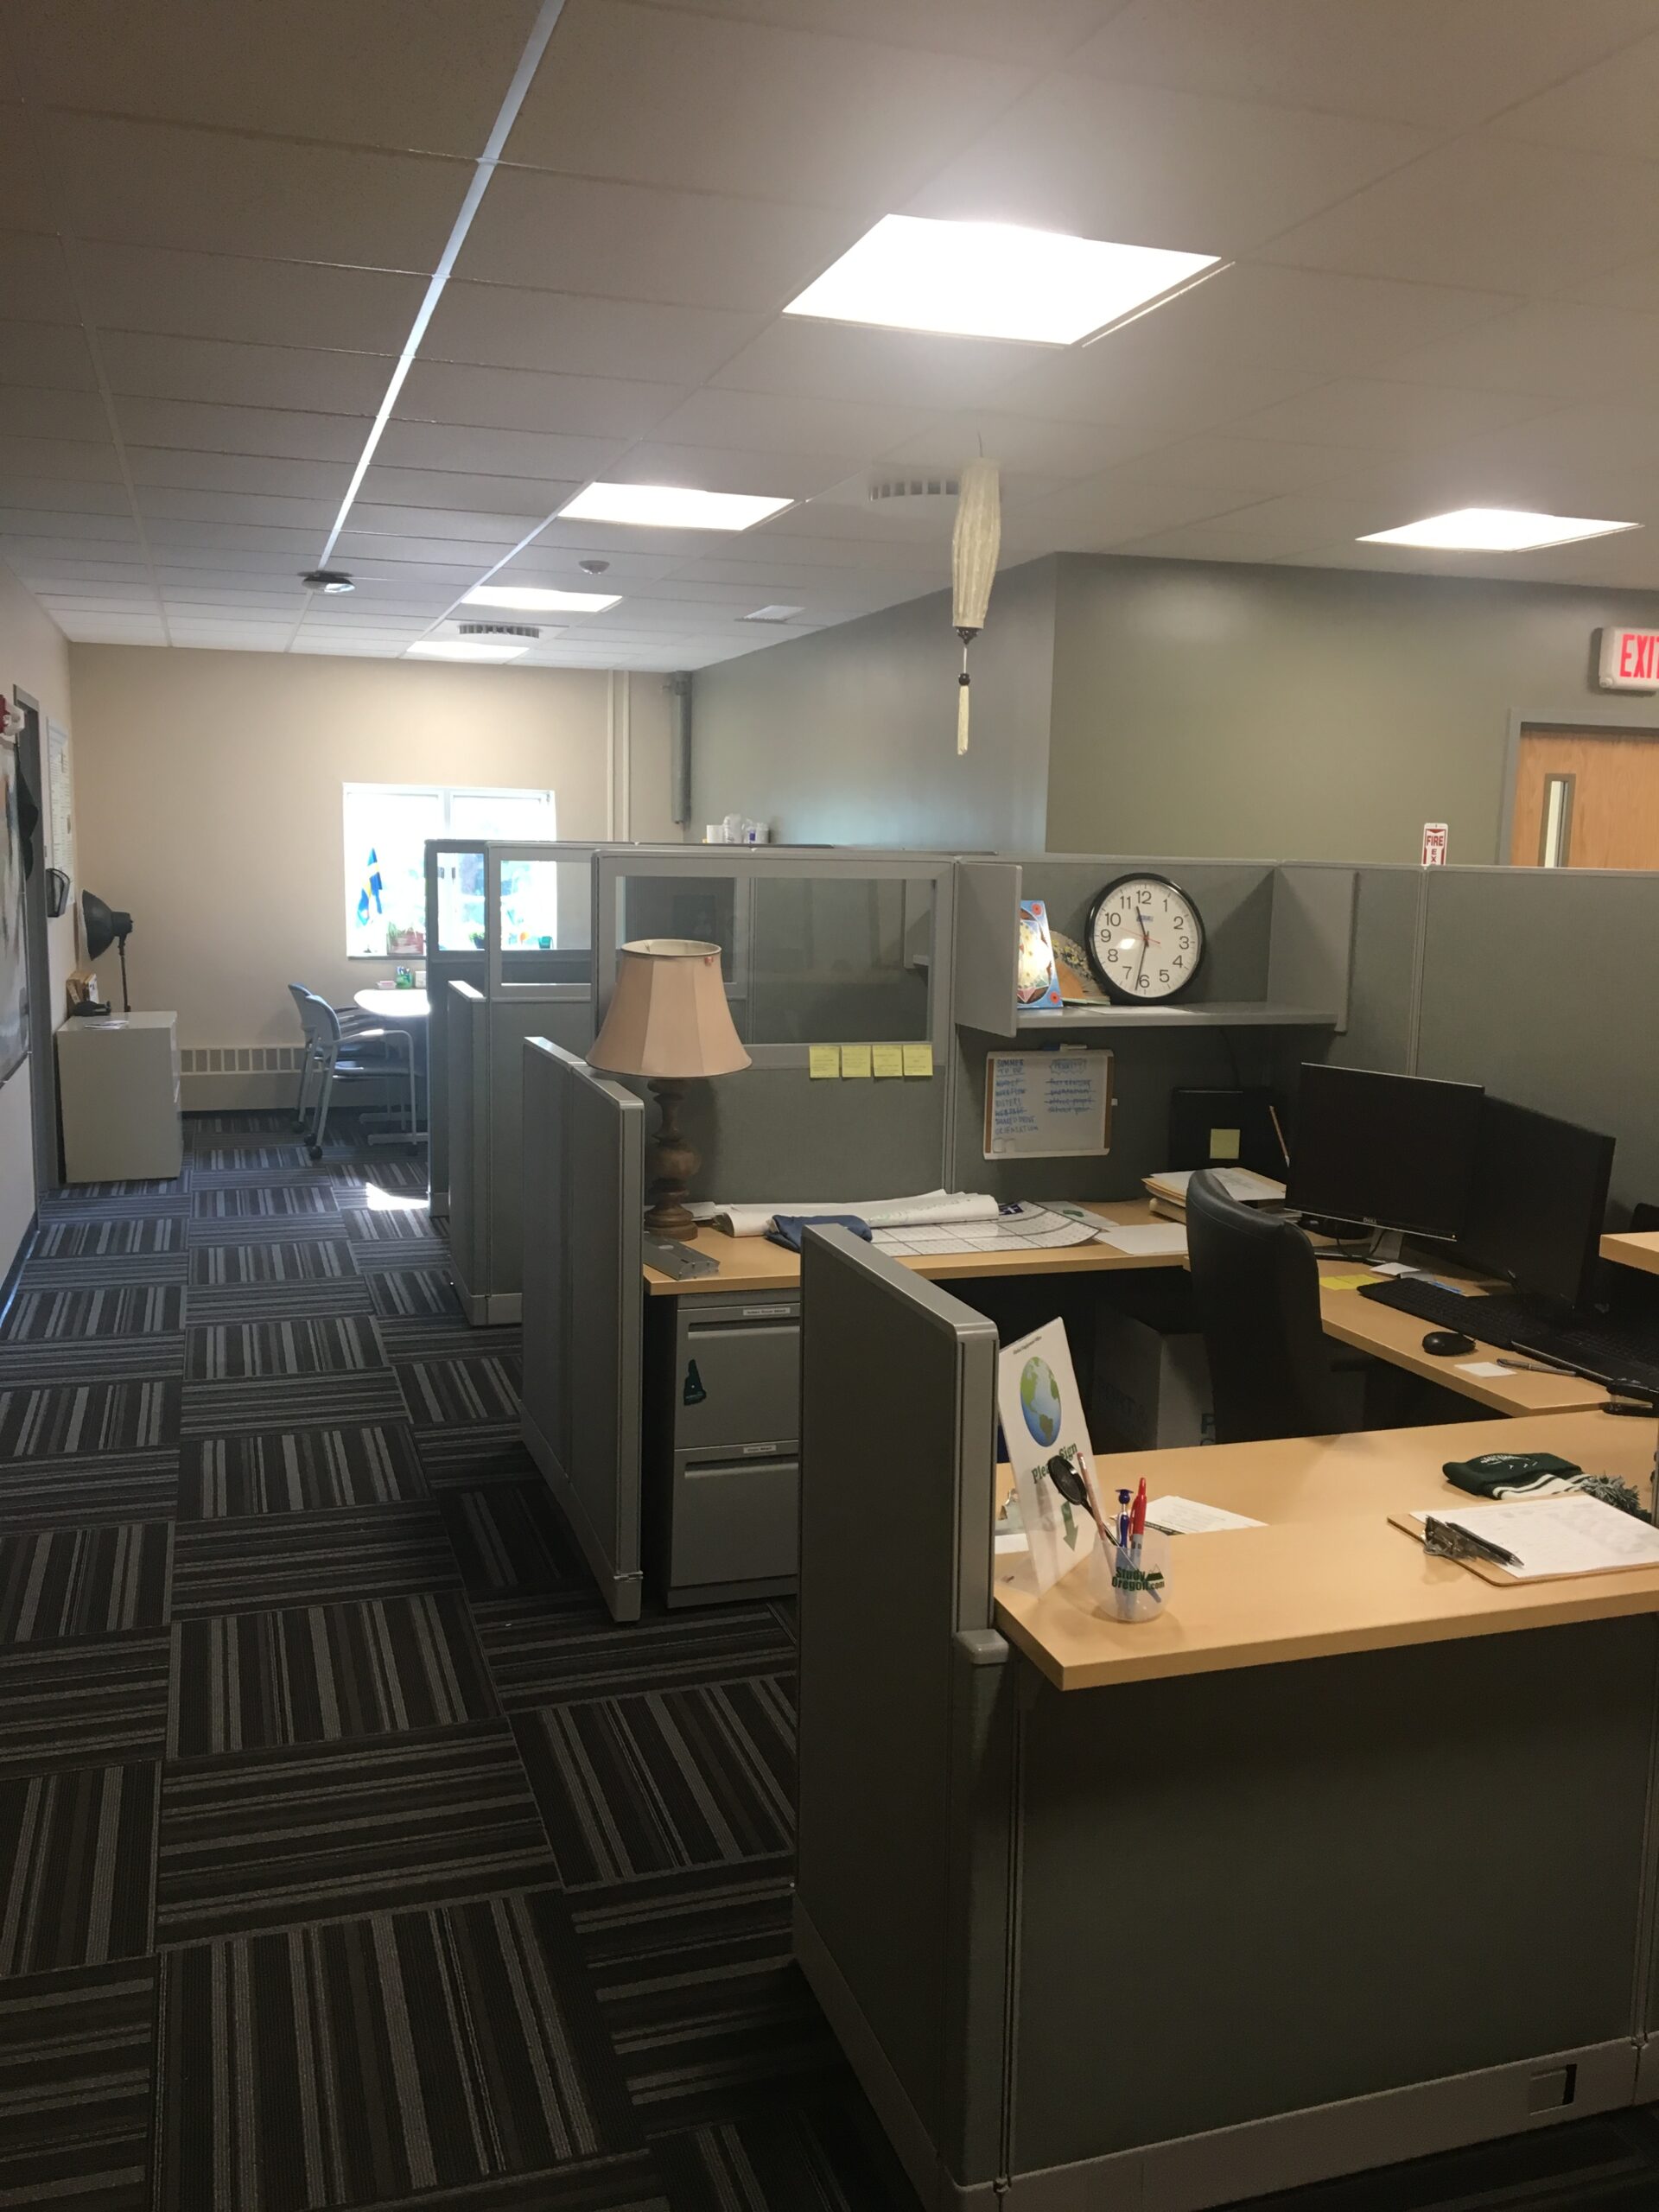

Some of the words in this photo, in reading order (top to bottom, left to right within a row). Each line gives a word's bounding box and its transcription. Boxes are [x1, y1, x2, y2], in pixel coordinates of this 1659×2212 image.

[1427, 836, 1444, 847] FIRE
[1120, 895, 1131, 910] 11
[1136, 890, 1152, 905] 12
[1163, 899, 1168, 912] 1
[1105, 912, 1122, 927] 10
[1173, 916, 1184, 930] 2
[1101, 929, 1111, 943] 9
[1179, 936, 1189, 950] 3
[1108, 949, 1118, 963] 8
[1173, 955, 1183, 969] 4
[1122, 966, 1133, 980] 7
[1160, 969, 1170, 982] 5
[1139, 975, 1150, 988] 6
[1116, 1567, 1146, 1581] Study
[1111, 1576, 1165, 1592] Oregon.com
